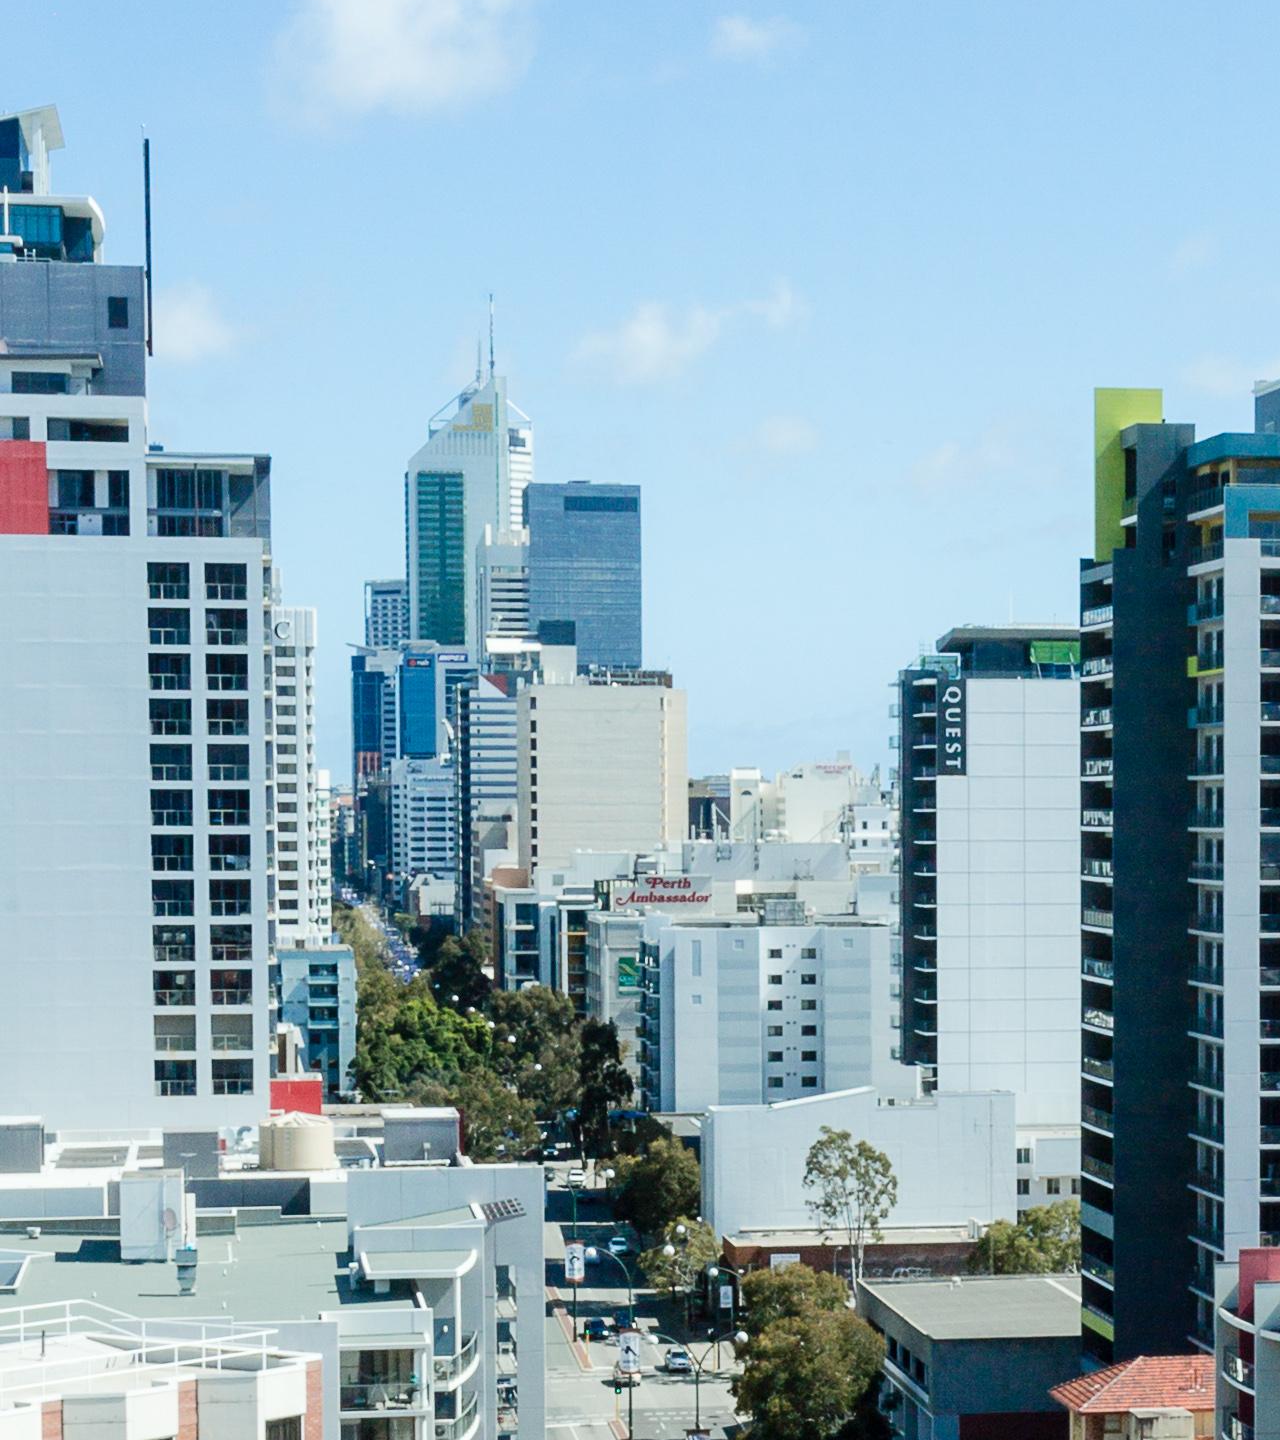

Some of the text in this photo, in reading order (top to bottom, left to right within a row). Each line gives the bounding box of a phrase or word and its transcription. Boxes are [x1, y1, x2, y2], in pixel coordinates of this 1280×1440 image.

[943, 686, 962, 769] QUEST
[645, 877, 692, 889] Perth
[616, 891, 713, 906] Ambassador
